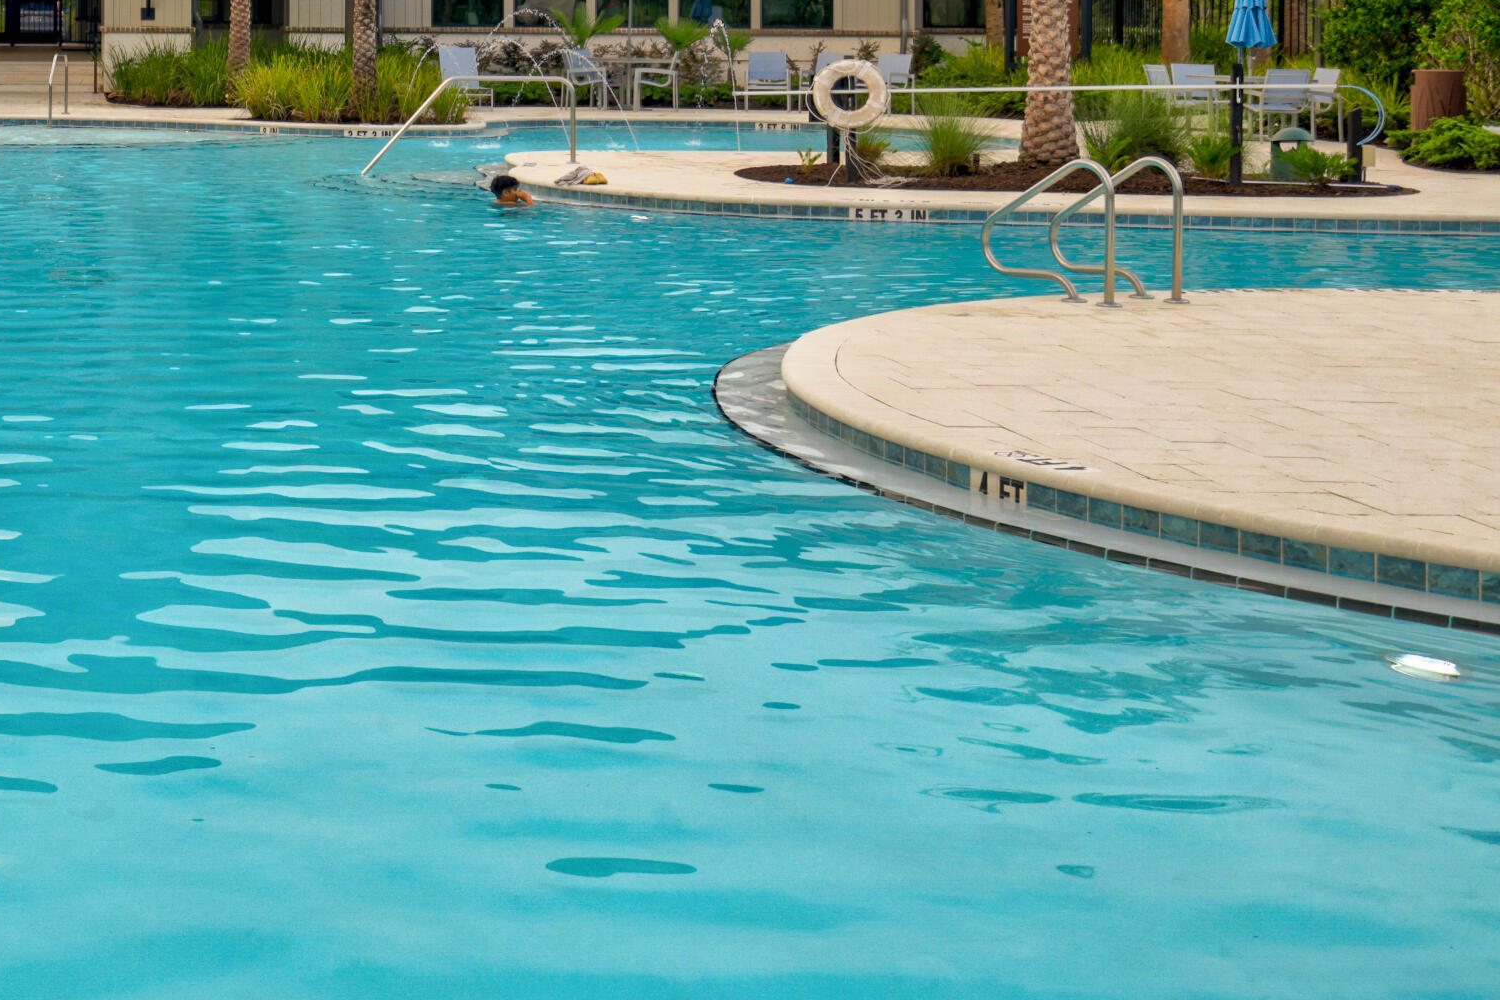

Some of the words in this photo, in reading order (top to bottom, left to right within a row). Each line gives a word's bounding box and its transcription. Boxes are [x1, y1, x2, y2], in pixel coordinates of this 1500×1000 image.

[870, 209, 887, 218] FT
[910, 209, 926, 220] IN
[979, 471, 988, 494] 4
[999, 475, 1024, 503] FT
